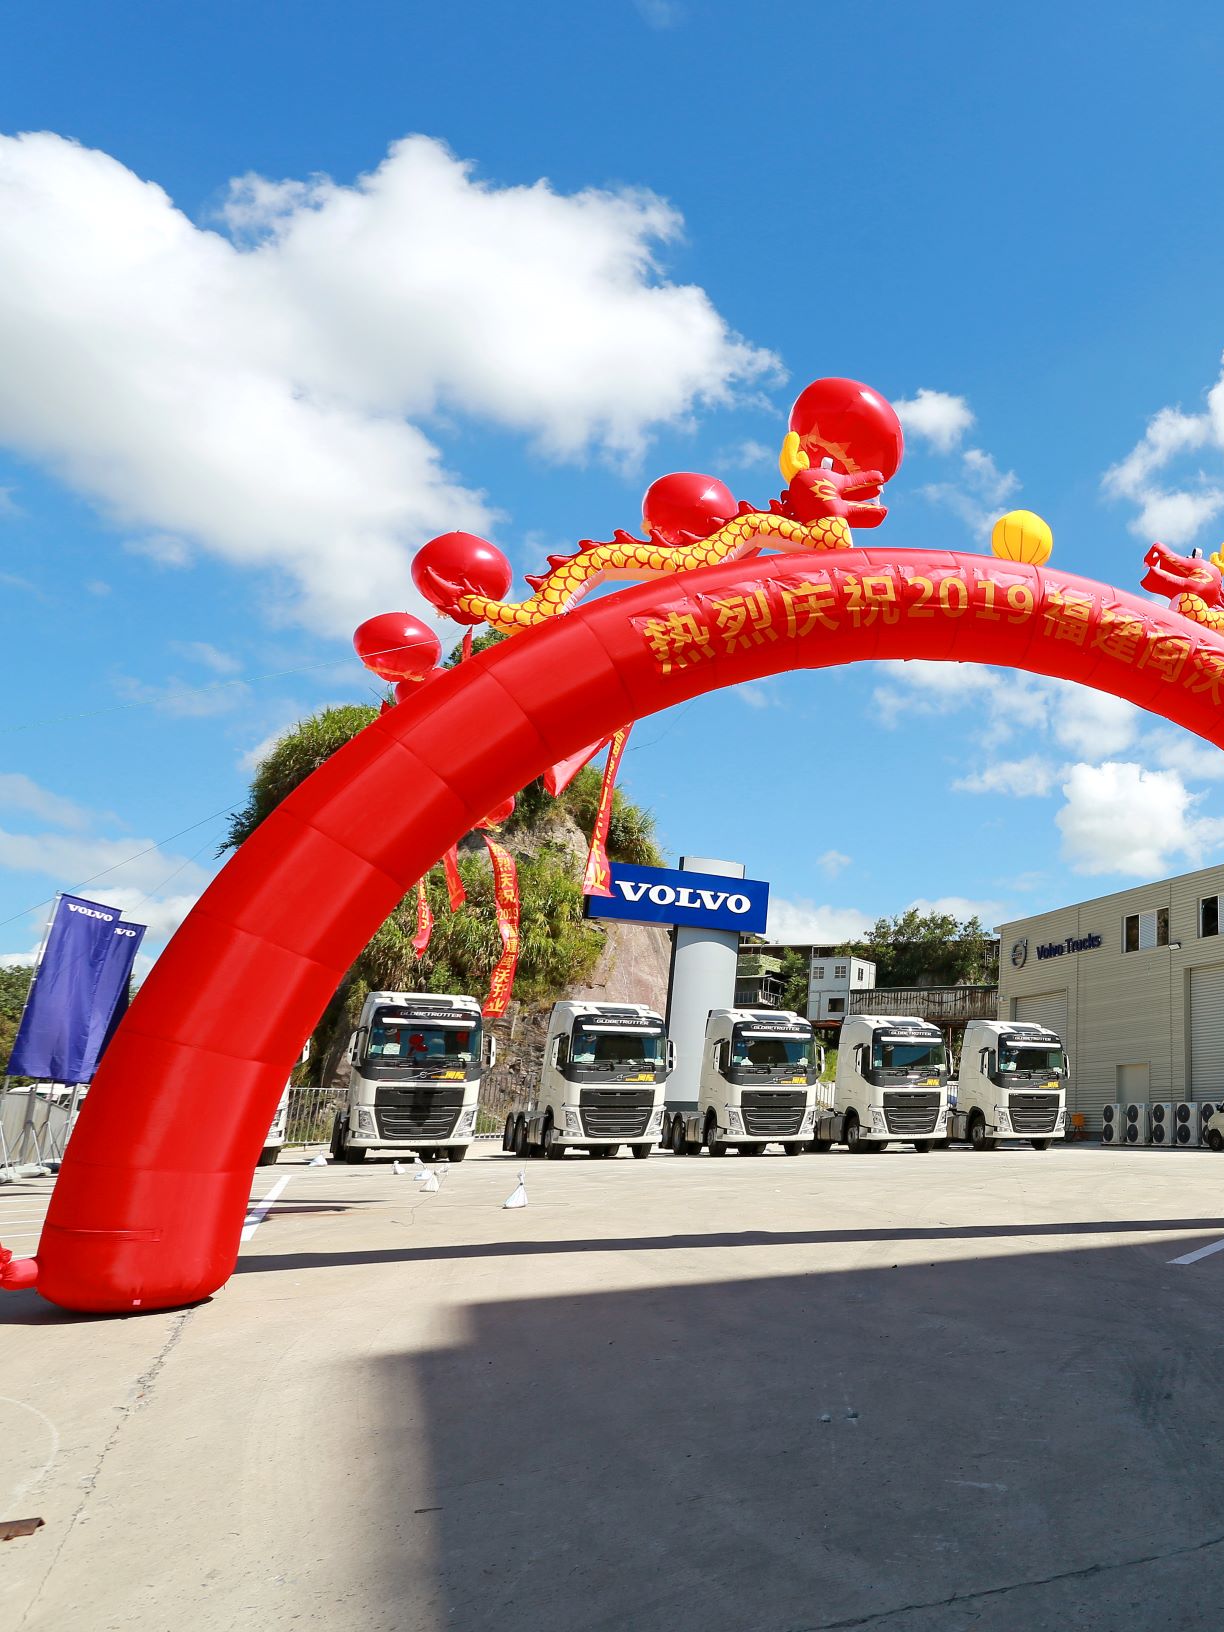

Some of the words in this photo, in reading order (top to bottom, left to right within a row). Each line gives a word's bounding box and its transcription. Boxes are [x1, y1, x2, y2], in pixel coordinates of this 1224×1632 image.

[614, 880, 751, 914] VOLVO
[66, 903, 114, 922] VOLVO
[1036, 942, 1064, 960] Volvo
[1065, 933, 1102, 953] Trucks
[596, 1018, 650, 1026] GLOBETROTTER
[753, 1024, 801, 1032] GLOBETROTTER
